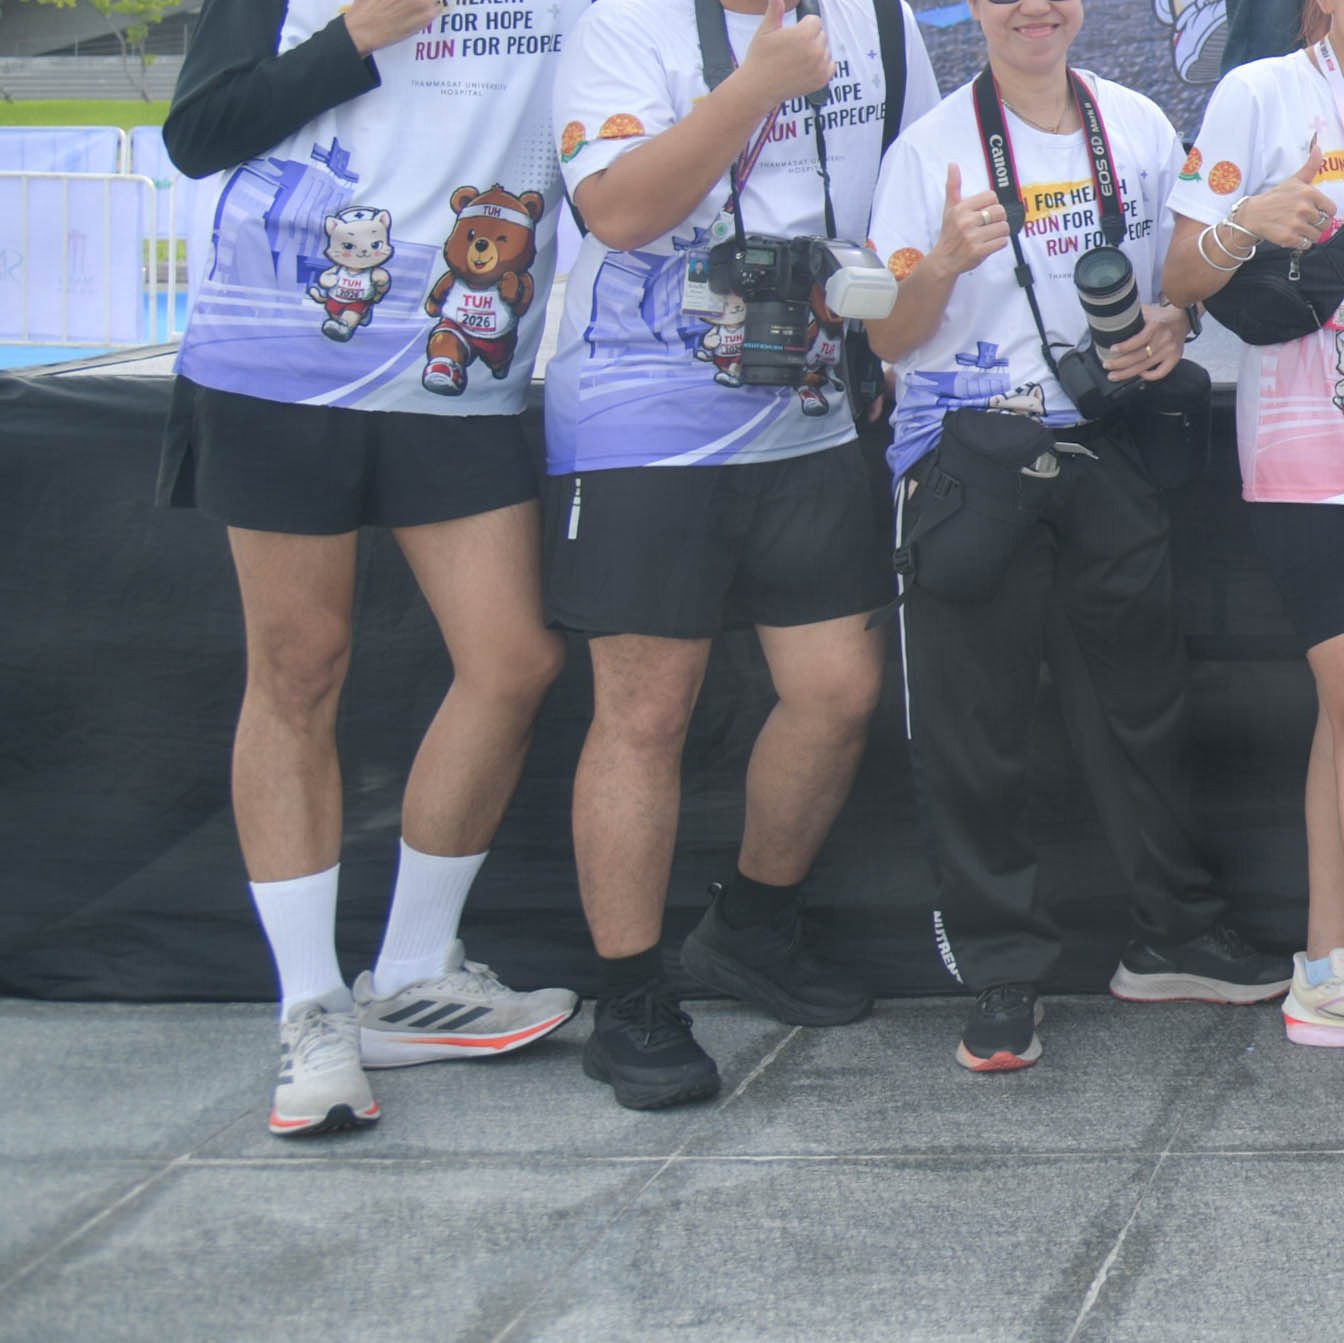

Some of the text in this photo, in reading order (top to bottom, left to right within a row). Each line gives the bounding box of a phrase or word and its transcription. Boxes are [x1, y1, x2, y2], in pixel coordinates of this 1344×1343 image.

[439, 9, 534, 33] FOR HOPE
[415, 33, 563, 61] RUN FOR PEOPLE
[440, 88, 483, 97] HOSPITAL
[1091, 136, 1105, 156] 6D
[988, 133, 1010, 189] Canon
[1095, 158, 1113, 197] EOS
[482, 205, 502, 217] TUH
[1034, 190, 1066, 211] FOR
[1023, 209, 1095, 238] RUN FOR
[1046, 235, 1079, 257] RUN
[342, 278, 363, 288] TUH
[462, 293, 494, 310] TUH
[461, 314, 492, 329] 2026
